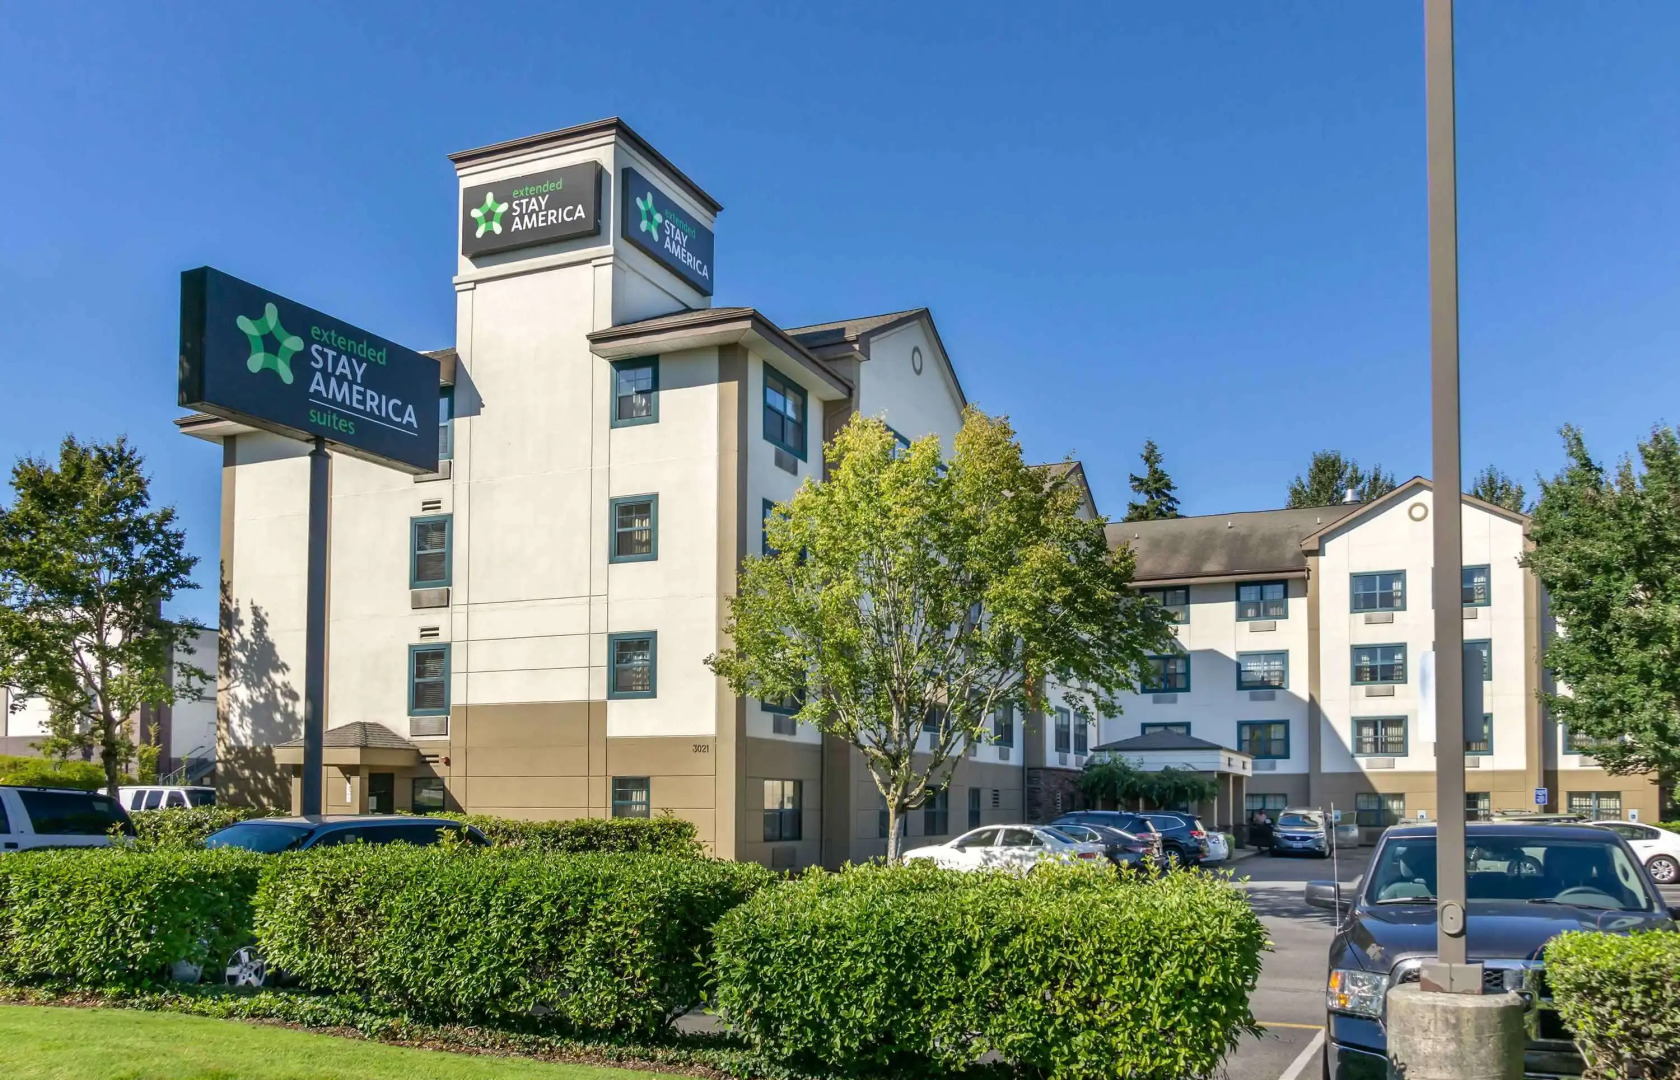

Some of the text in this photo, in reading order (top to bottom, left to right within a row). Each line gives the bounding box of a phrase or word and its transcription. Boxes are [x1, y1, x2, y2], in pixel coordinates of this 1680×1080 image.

[512, 177, 563, 198] extended
[511, 204, 586, 232] AMERICA
[512, 194, 549, 216] STAY
[664, 208, 696, 239] extended
[664, 219, 688, 248] STAY
[664, 236, 709, 280] AMERICA
[311, 325, 387, 366] extended
[310, 344, 368, 383] STAY
[309, 371, 418, 429] AMERICA
[309, 409, 356, 435] suites
[692, 744, 709, 753] 3021
